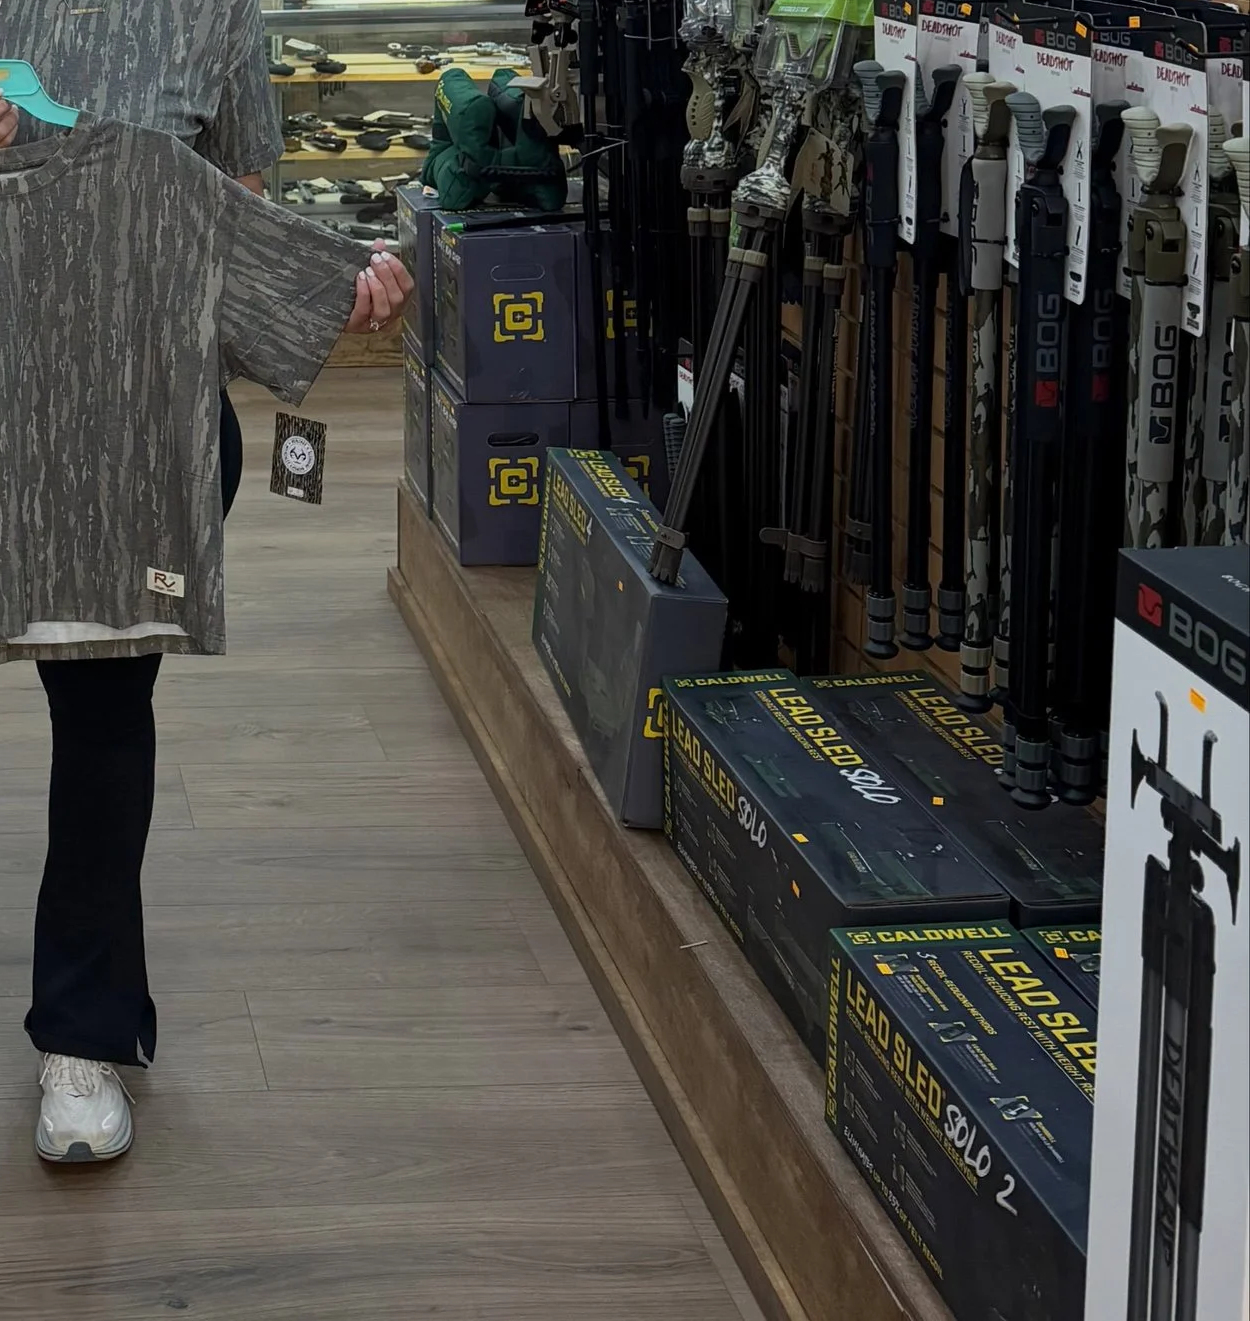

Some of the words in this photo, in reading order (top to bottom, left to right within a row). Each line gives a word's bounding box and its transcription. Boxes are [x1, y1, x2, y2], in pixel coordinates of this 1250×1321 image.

[882, 23, 907, 39] DEADSHOT
[922, 20, 963, 37] DEADSHOT
[1046, 31, 1077, 50] BOG
[1164, 46, 1193, 65] BOG
[1037, 52, 1074, 71] DEADSHOT
[1156, 66, 1191, 86] DEADSHOT
[1221, 63, 1243, 78] DEAD
[1036, 293, 1060, 373] BOG
[1092, 289, 1114, 368] BOG
[1151, 325, 1178, 408] BOG
[553, 470, 570, 510] LEAD
[569, 501, 587, 534] SLED
[1169, 602, 1246, 686] BOG
[696, 673, 787, 686] CALDWELL
[833, 674, 925, 688] CALDWELL
[768, 687, 825, 726] LEAD
[805, 727, 864, 767] SLED
[839, 767, 901, 804] SOLO
[807, 748, 825, 762] REST
[907, 687, 970, 726] LEAD
[952, 727, 1004, 766] SLED
[671, 709, 701, 768] LEAD
[704, 750, 735, 812] SLED
[737, 796, 767, 848] SOLO
[877, 926, 1011, 943] CALDWELL
[926, 959, 973, 1008] RECOIL-REDUCING
[968, 1008, 998, 1036] METHODS
[979, 948, 1060, 1007] LEAD
[828, 957, 841, 1095] CALDWELL
[959, 950, 1022, 1012] RECOIL-REDUCING
[1016, 1012, 1039, 1030] REST
[1033, 1033, 1057, 1051] WITH
[1052, 1052, 1085, 1080] WEIGHT
[846, 969, 889, 1051] LEAD
[893, 1032, 944, 1120] SLED
[943, 1104, 992, 1178] SOLO
[996, 1173, 1018, 1217] 2
[906, 1086, 922, 1111] WITH
[923, 1108, 944, 1141] WEIGHT
[1156, 1032, 1182, 1268] DEATHGRIP
[844, 1125, 874, 1173] ELIMINATES
[907, 1221, 922, 1246] FELT
[921, 1241, 944, 1281] RECOIL
